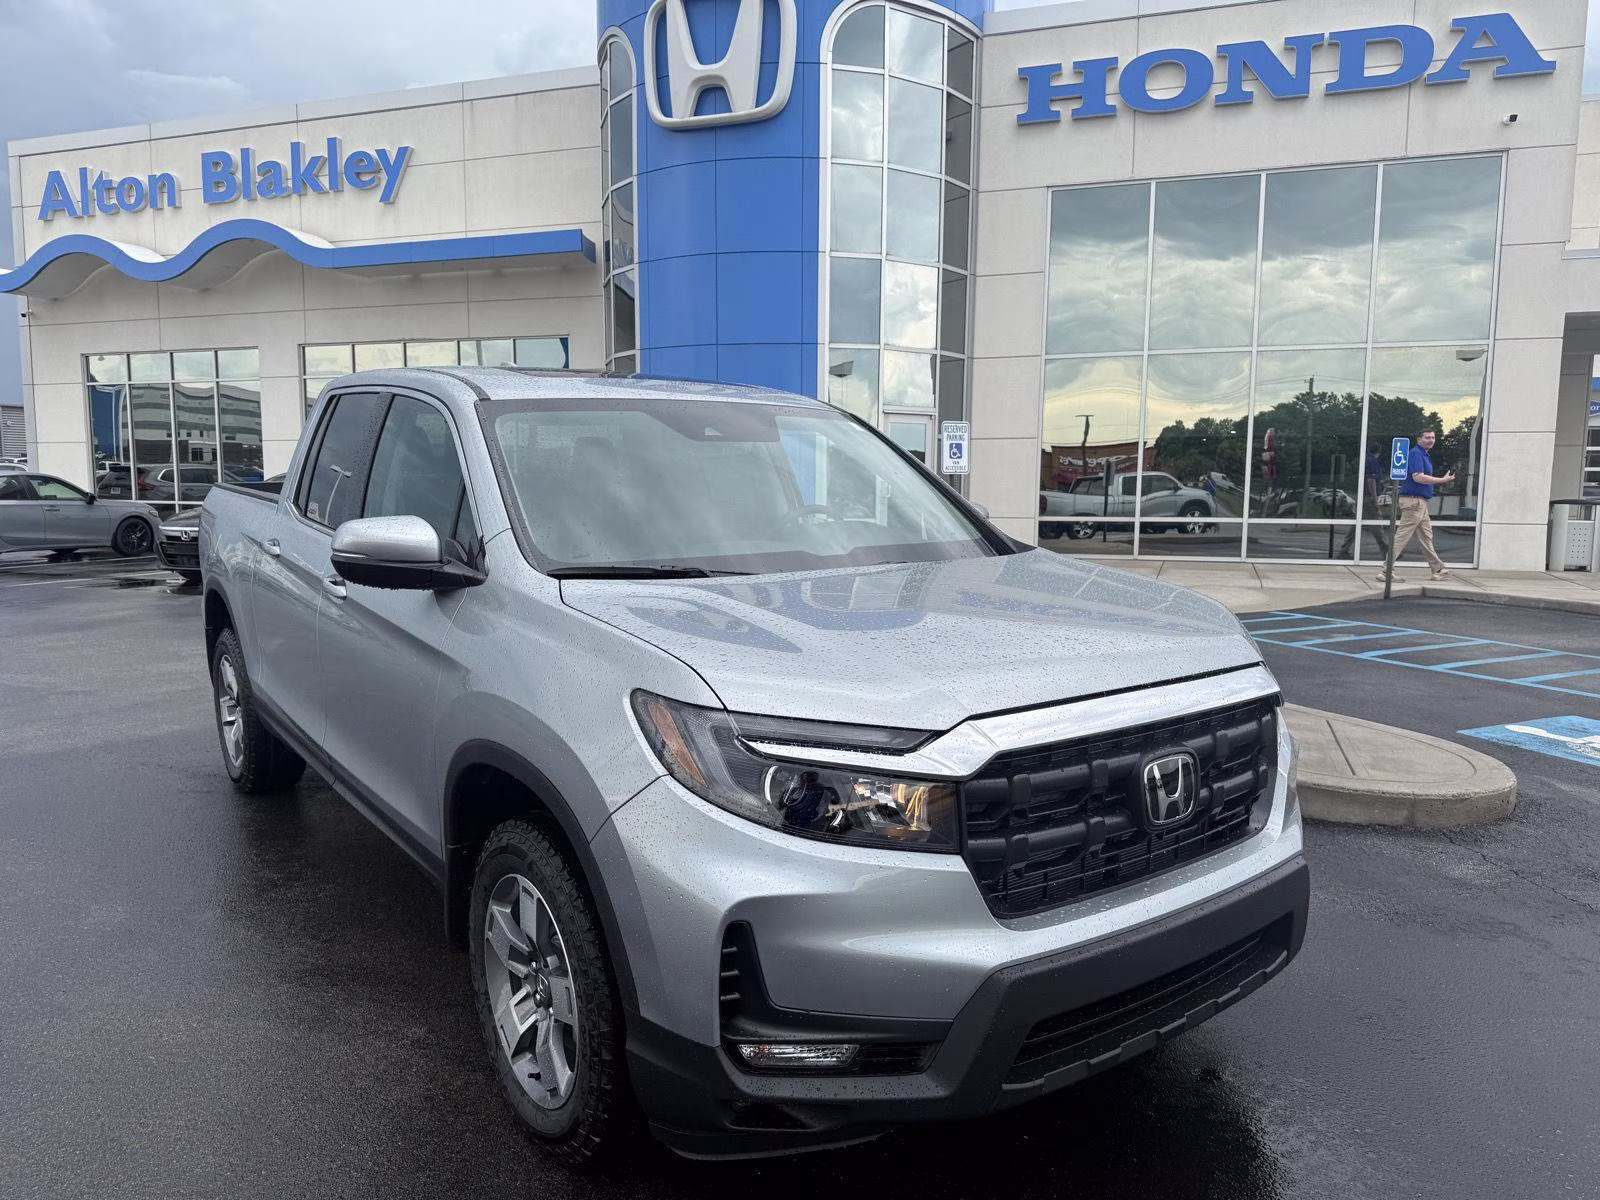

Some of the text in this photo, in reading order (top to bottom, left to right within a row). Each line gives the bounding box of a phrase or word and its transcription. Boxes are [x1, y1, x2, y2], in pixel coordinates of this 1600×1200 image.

[1016, 12, 1557, 125] HONDA
[38, 137, 412, 220] Alton Blakley
[945, 425, 967, 433] RESERVED
